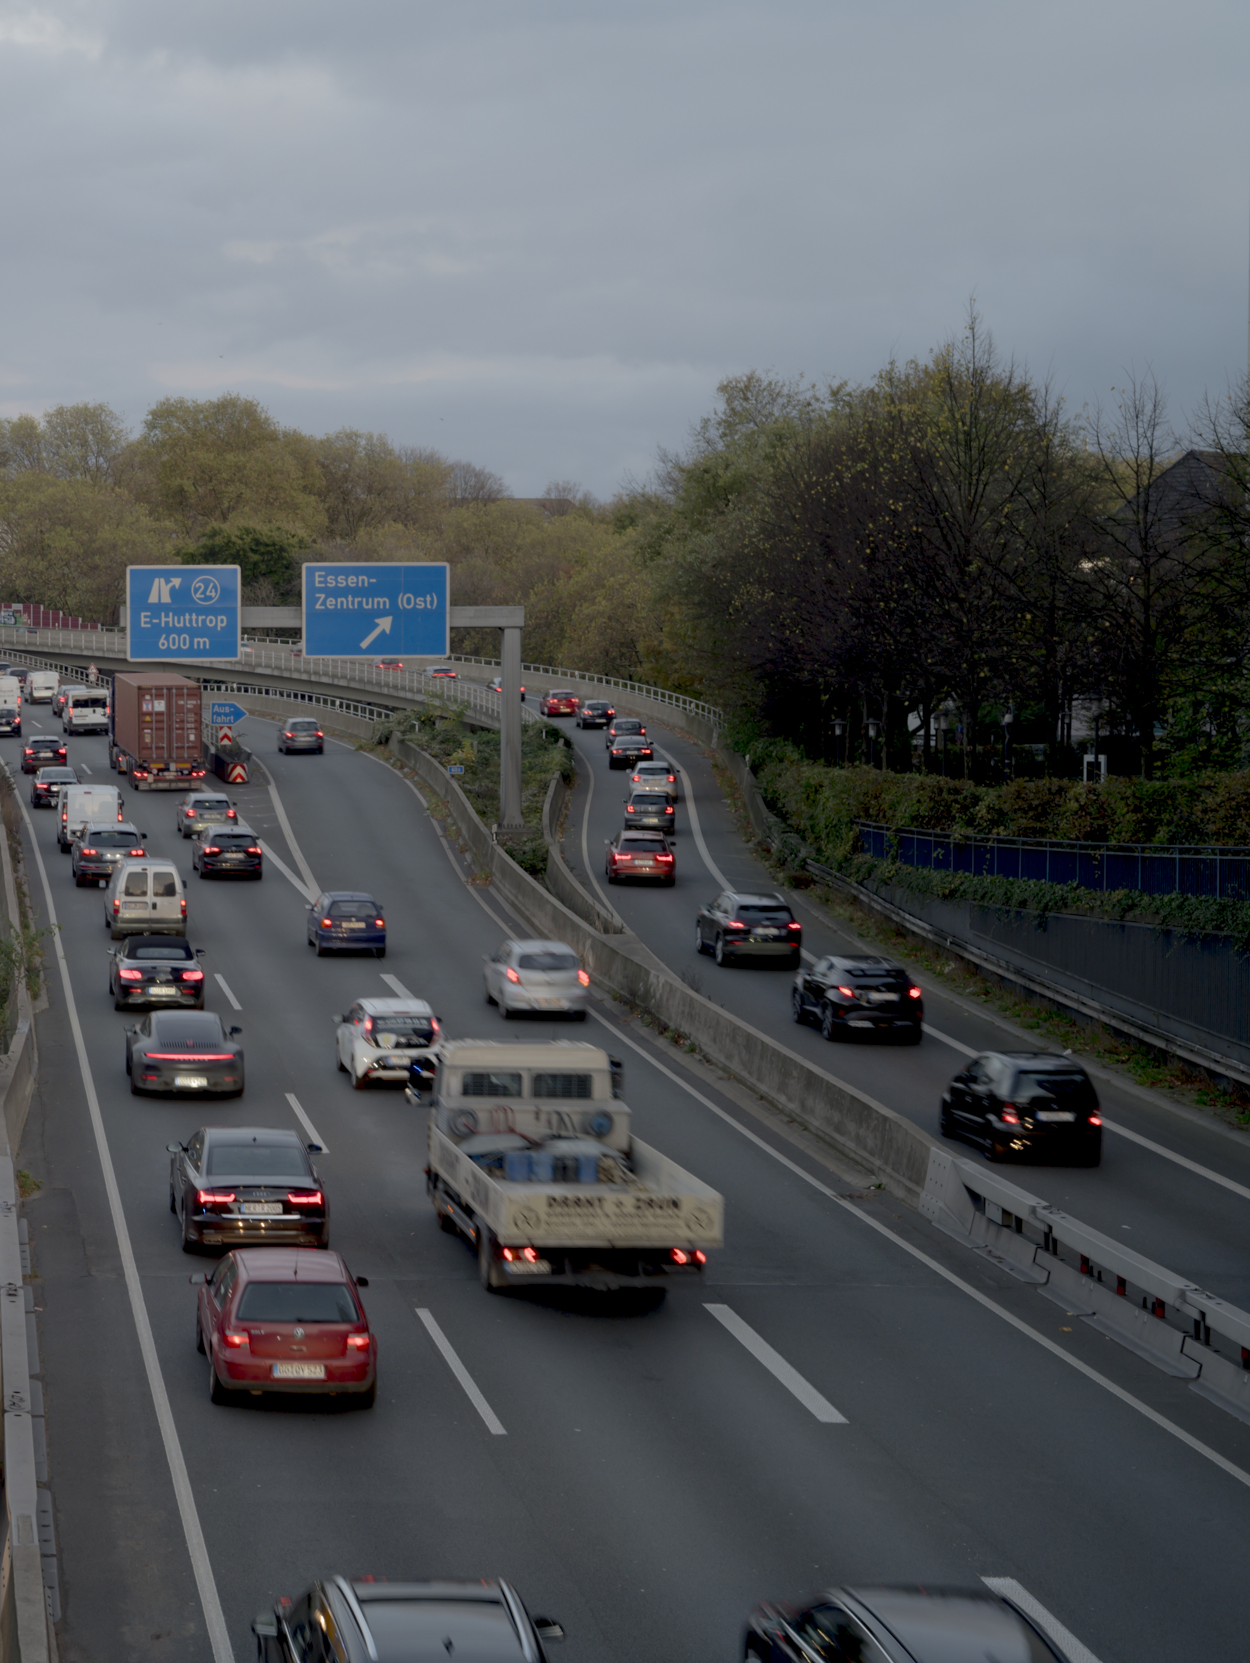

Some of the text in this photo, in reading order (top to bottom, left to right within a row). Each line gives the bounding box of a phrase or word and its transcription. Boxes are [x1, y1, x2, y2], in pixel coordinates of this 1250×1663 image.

[315, 571, 376, 587] Essen-
[195, 582, 216, 598] 24
[315, 592, 437, 610] Zentrum (Ost)
[140, 611, 227, 631] E-Huttrop
[158, 633, 210, 650] 600 m
[213, 704, 235, 713] Aus-
[213, 714, 235, 724] fahrt
